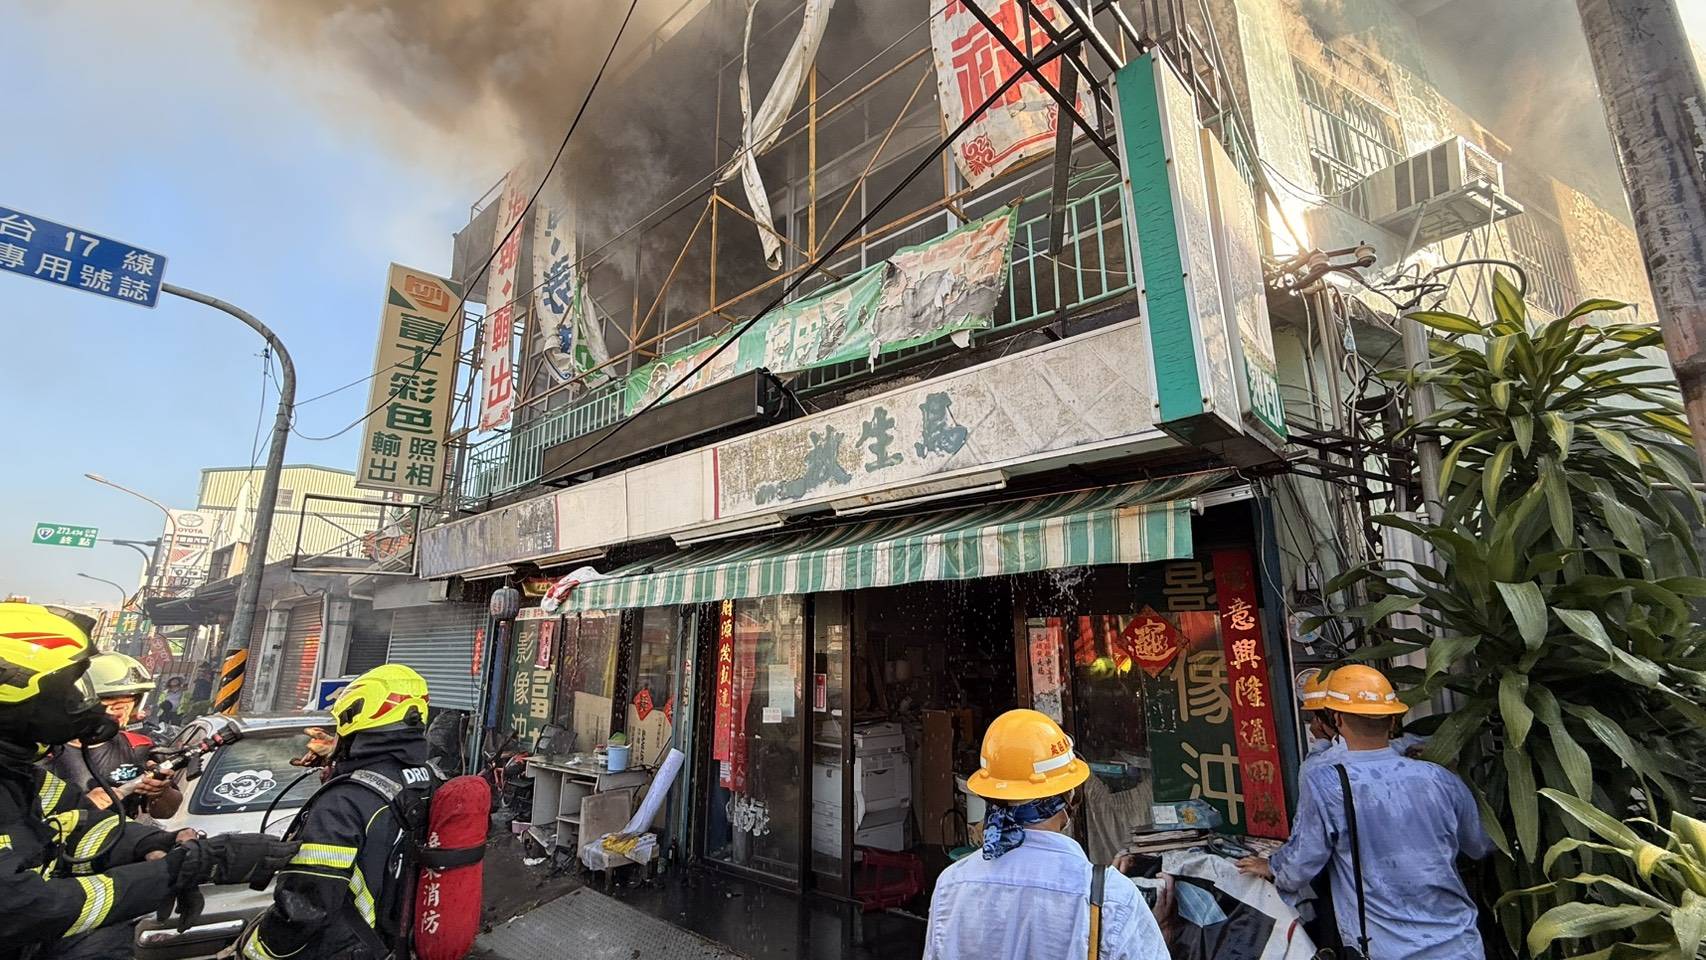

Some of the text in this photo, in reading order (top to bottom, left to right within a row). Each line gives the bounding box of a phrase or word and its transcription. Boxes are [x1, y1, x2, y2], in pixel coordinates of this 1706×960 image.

[0, 242, 151, 301] 專用號誌
[386, 312, 446, 435] 富士彩色
[367, 431, 402, 483] 輸出
[405, 436, 438, 487] 照相
[173, 527, 204, 535] OYOTA
[402, 767, 430, 785] DRD
